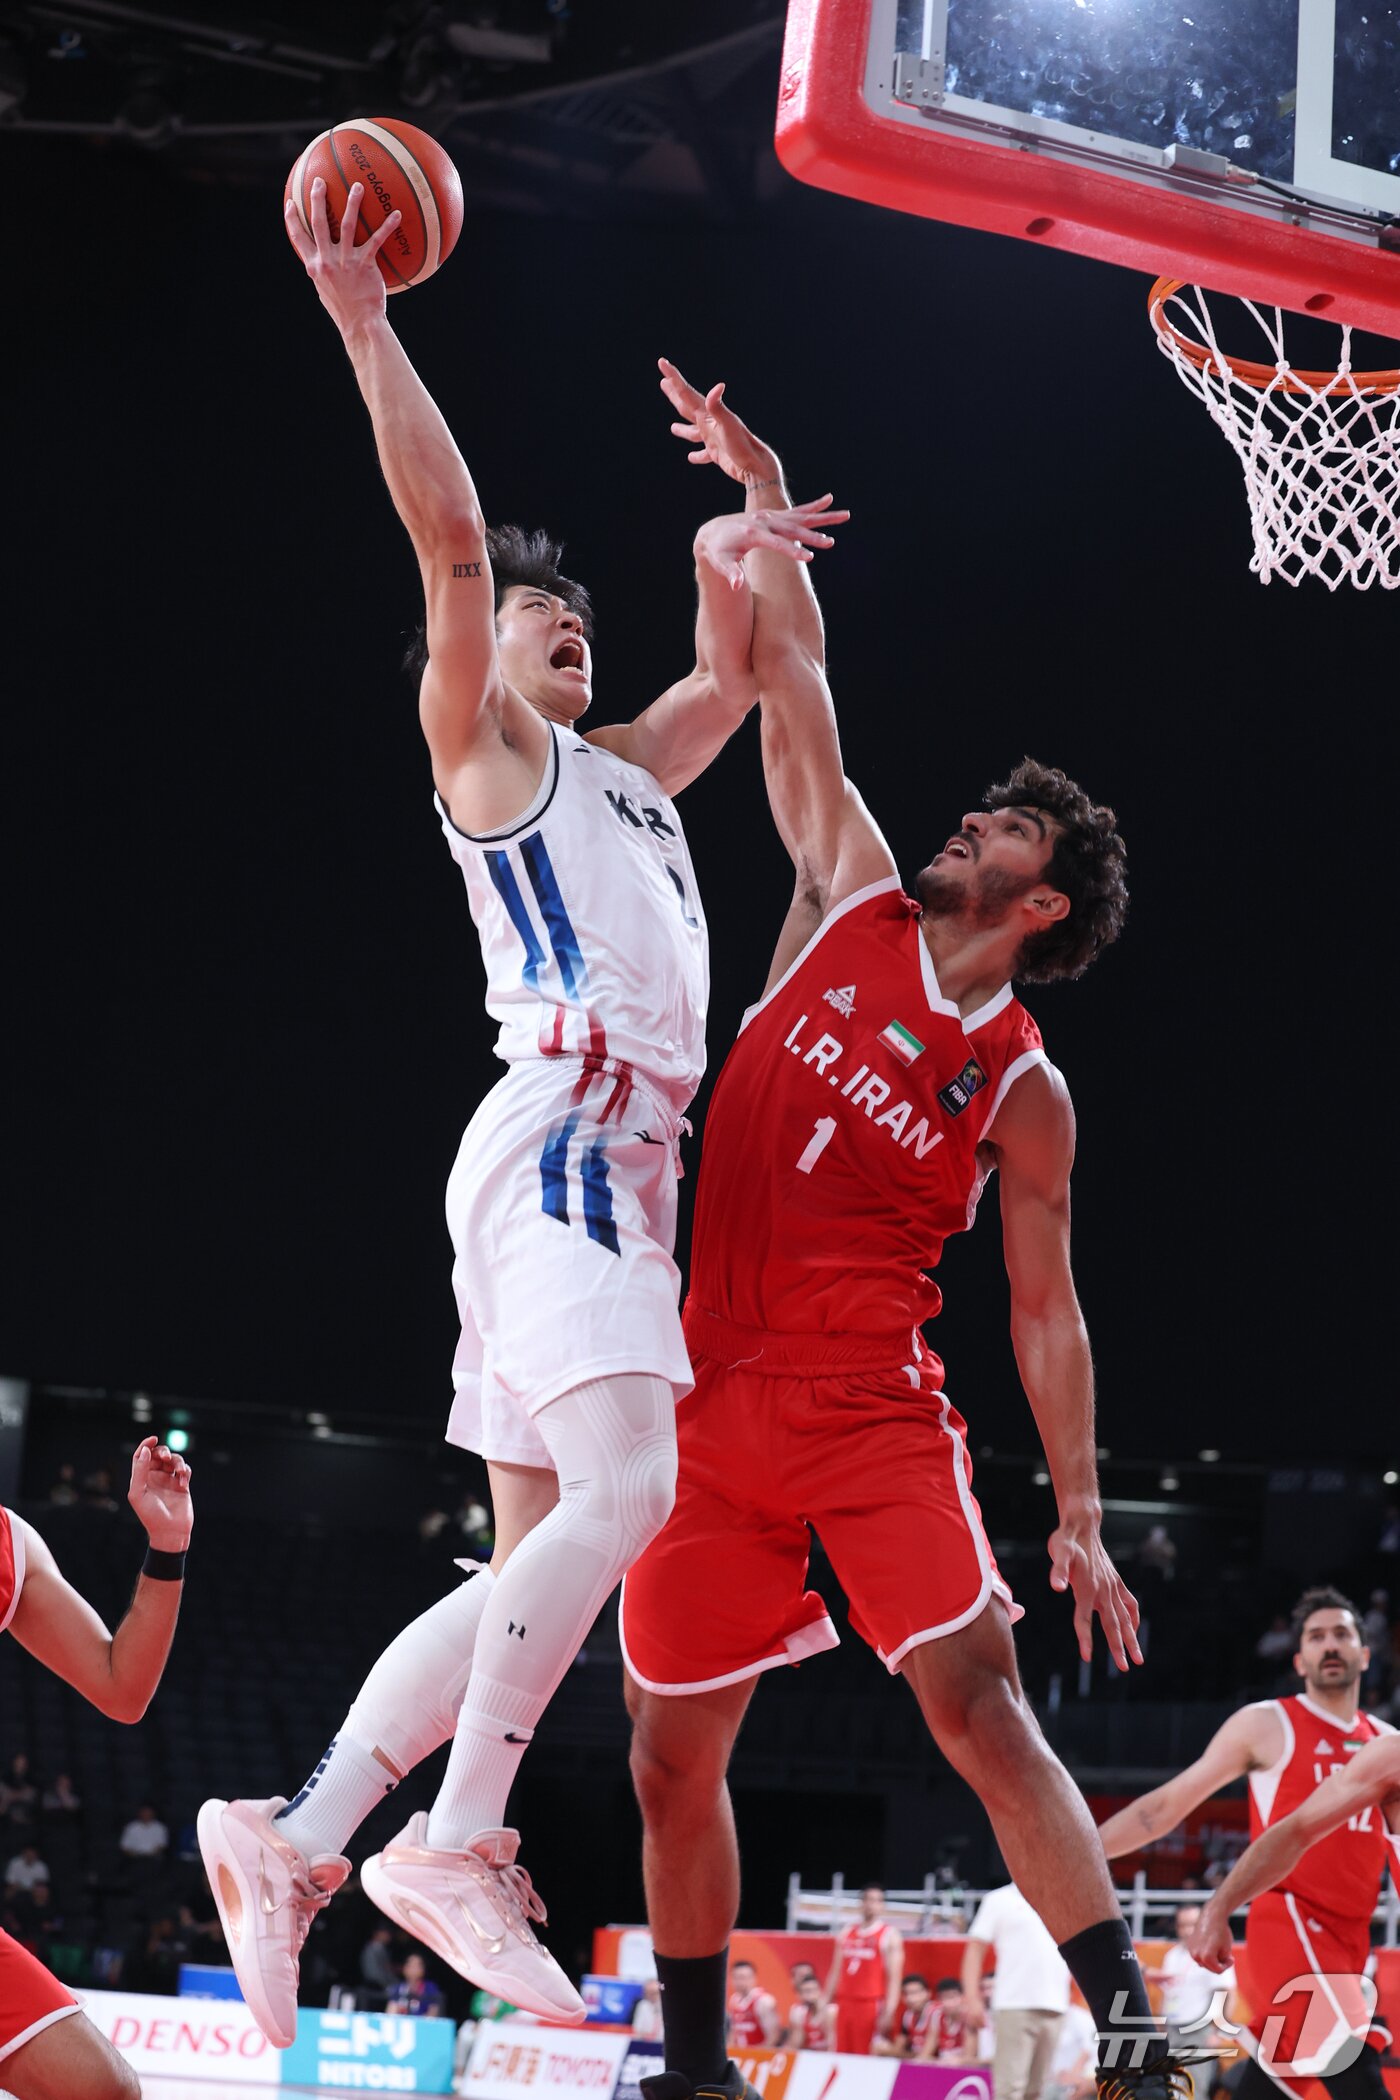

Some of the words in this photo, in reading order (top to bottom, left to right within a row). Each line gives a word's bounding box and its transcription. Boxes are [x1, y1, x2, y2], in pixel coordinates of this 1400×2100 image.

[349, 143, 371, 171] 2026
[367, 171, 394, 217] agoya
[948, 1083, 967, 1106] FIBA
[795, 1115, 838, 1174] 1
[111, 2015, 270, 2059] DENSO
[317, 2012, 417, 2060] ニトリ
[318, 2060, 417, 2091] NITORI
[546, 2053, 613, 2088] TOYOTA
